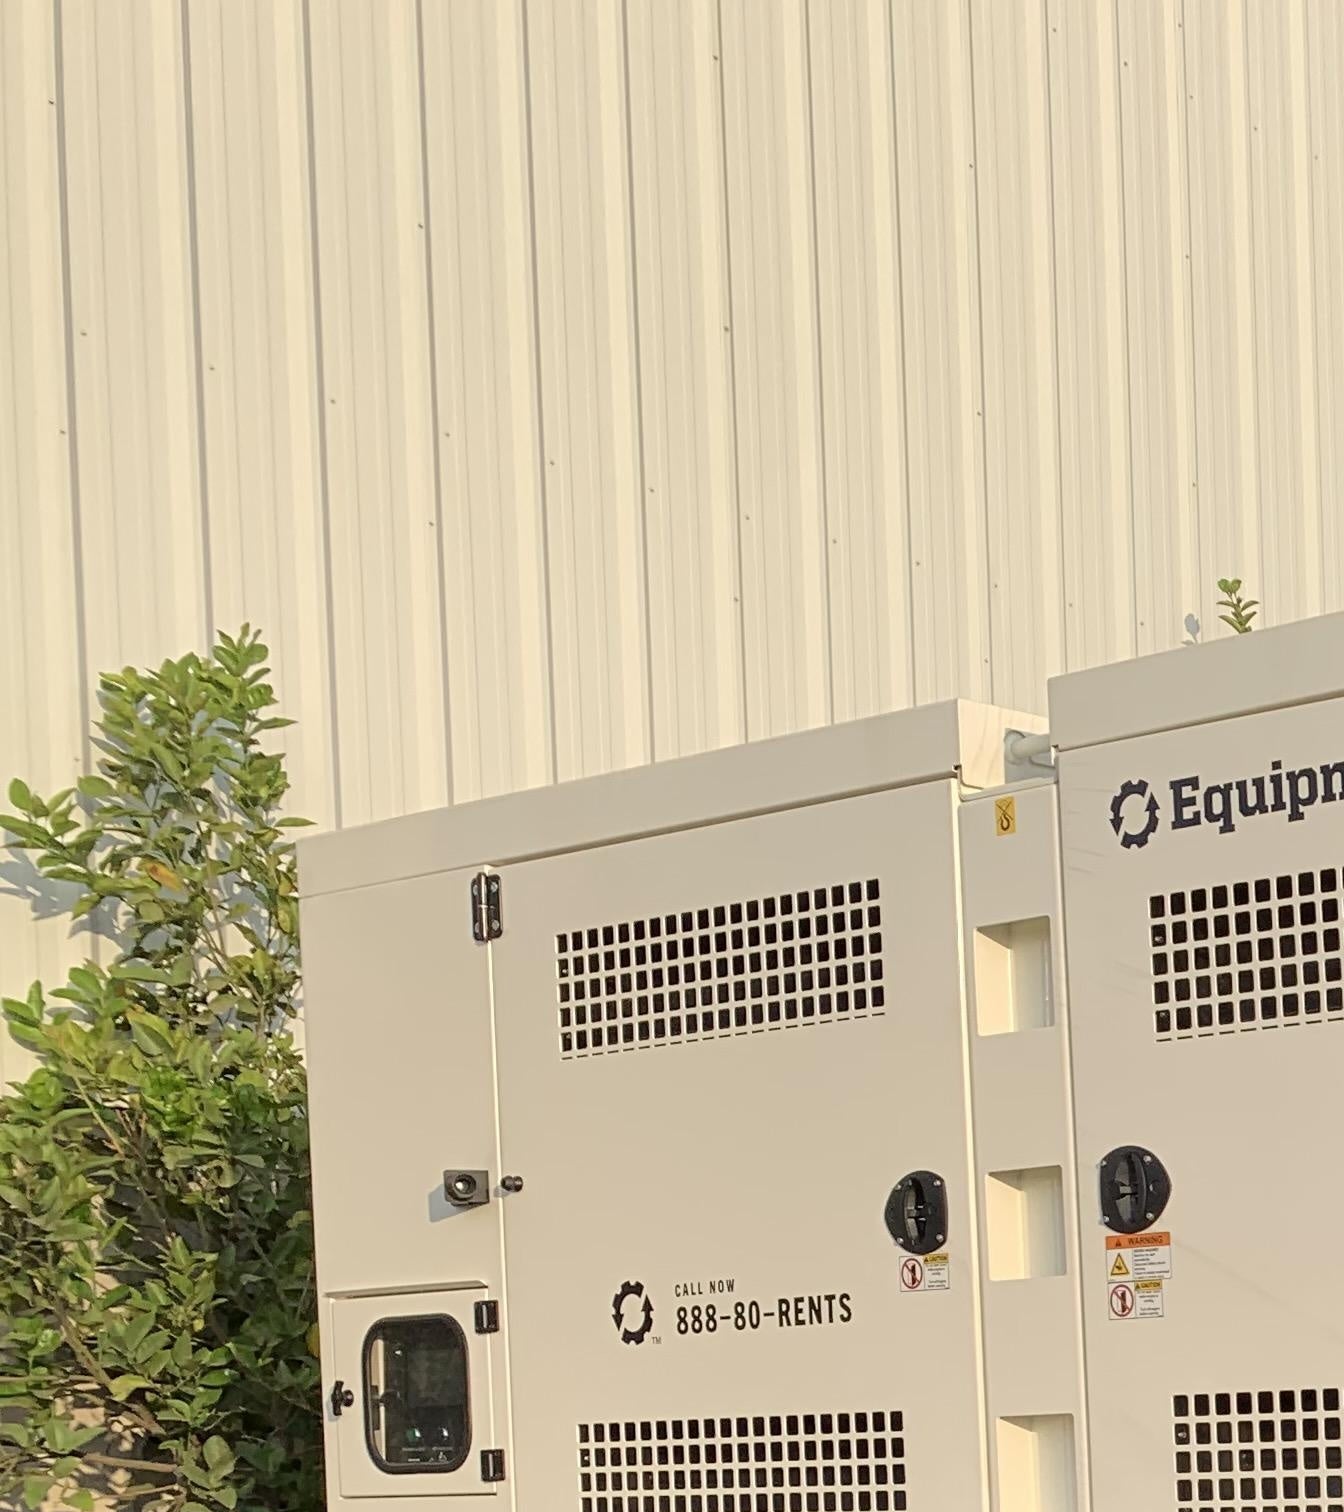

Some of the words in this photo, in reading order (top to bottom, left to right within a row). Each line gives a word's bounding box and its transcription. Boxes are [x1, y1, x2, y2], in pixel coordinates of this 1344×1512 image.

[1128, 1235, 1164, 1246] WARNING
[674, 1281, 704, 1298] CALL
[709, 1278, 736, 1295] NOW
[675, 1292, 853, 1336] 888-80-RENTS
